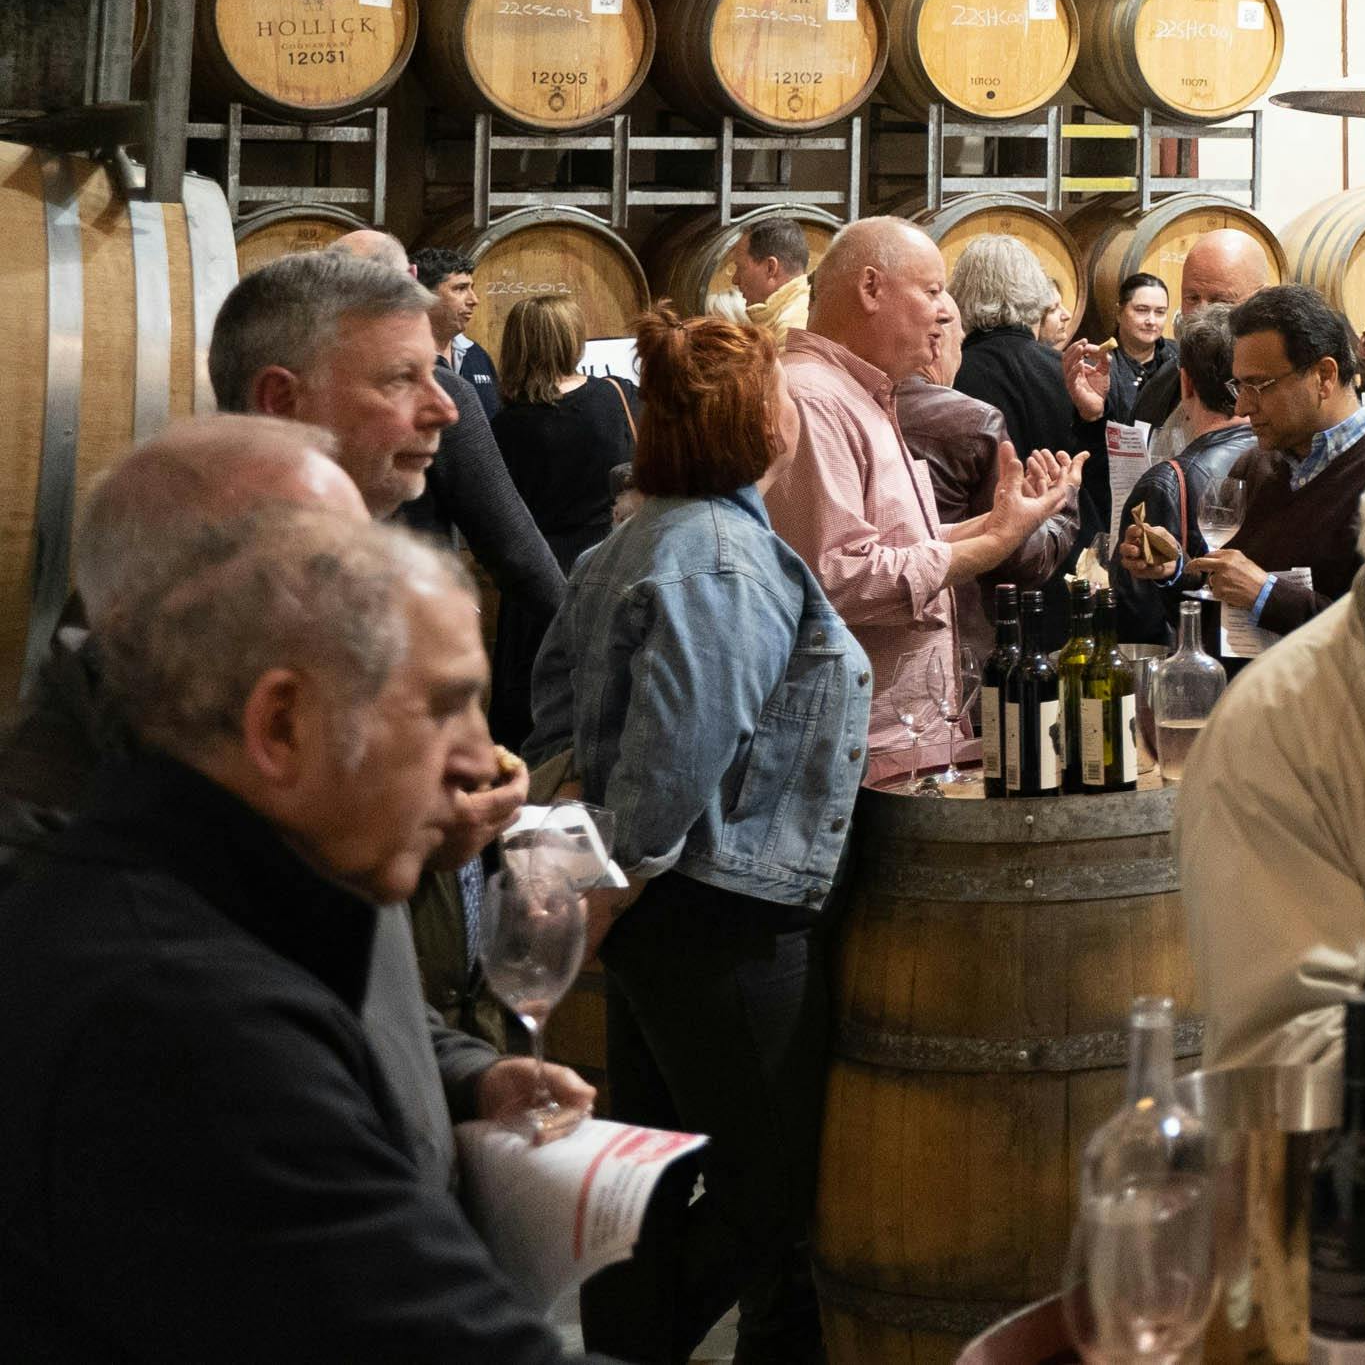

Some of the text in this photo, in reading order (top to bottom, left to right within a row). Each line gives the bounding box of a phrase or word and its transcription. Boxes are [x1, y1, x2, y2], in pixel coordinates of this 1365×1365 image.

[257, 18, 373, 37] HOLLICK
[288, 51, 345, 65] 12051
[775, 72, 823, 84] 12102
[487, 282, 572, 295] 22CSC012
